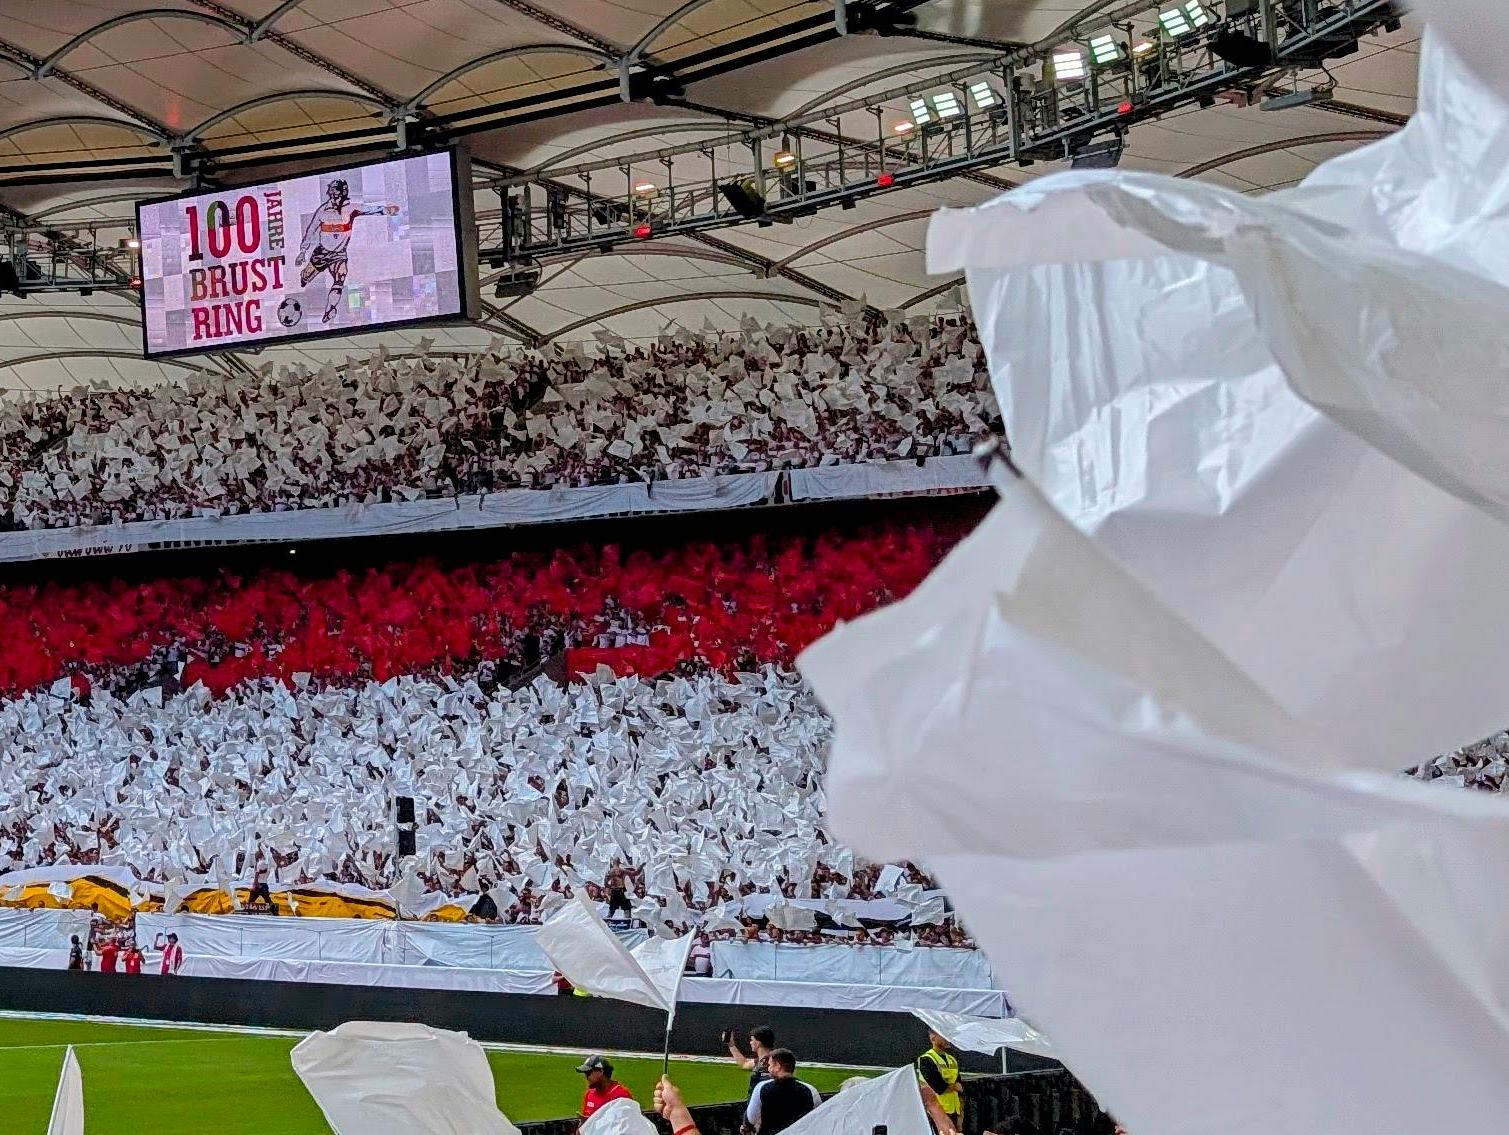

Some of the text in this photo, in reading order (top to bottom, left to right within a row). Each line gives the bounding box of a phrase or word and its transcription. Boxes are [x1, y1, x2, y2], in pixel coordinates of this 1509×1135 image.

[186, 195, 260, 261] 100
[263, 190, 284, 251] JAHRE
[189, 255, 285, 301] BRUST
[192, 299, 262, 340] RING
